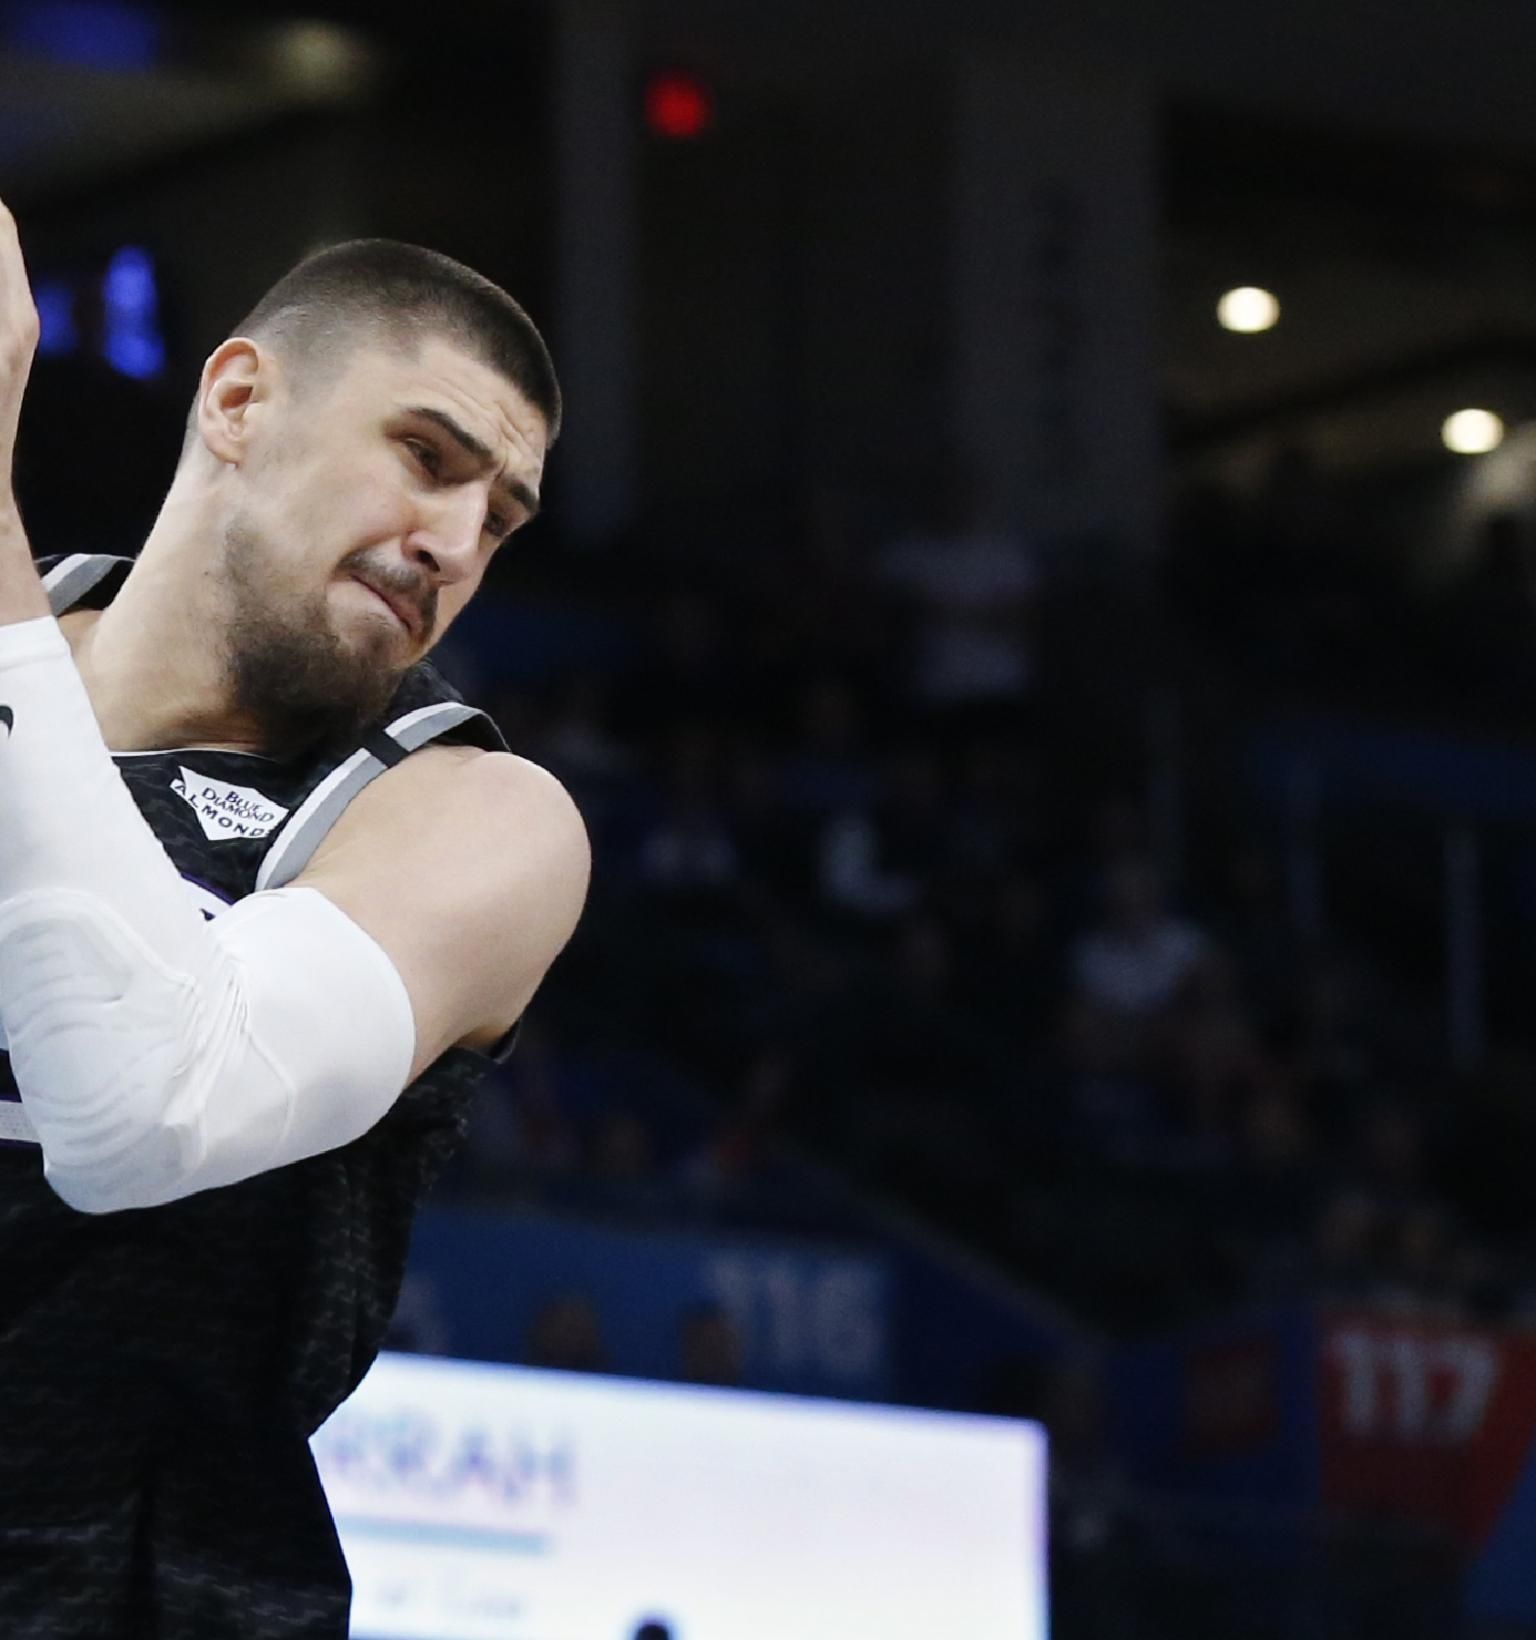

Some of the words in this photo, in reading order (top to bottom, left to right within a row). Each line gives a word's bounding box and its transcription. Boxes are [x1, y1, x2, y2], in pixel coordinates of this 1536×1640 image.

[202, 787, 275, 822] DIAMOND
[225, 791, 263, 812] BLUE
[1332, 1332, 1496, 1440] 117
